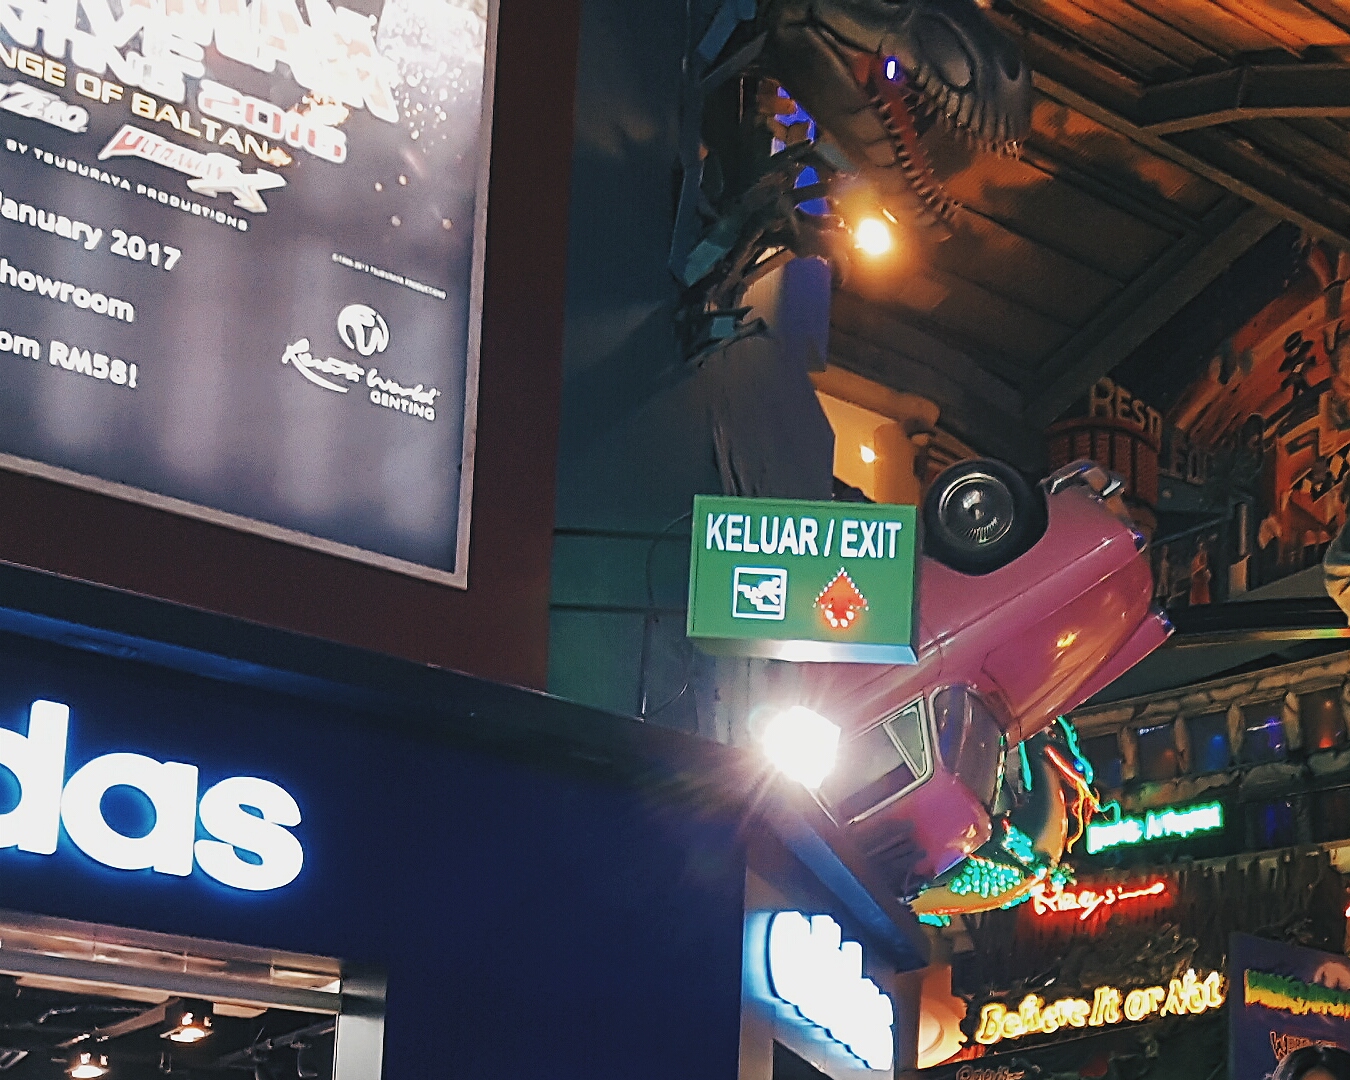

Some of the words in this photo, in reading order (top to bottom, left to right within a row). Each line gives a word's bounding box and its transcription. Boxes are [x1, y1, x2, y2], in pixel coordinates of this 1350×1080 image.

[75, 72, 124, 104] OF
[131, 92, 270, 160] BALTAN
[6, 138, 28, 154] BY
[136, 183, 249, 232] PRODUCTIONS
[0, 196, 103, 250] anuary
[110, 229, 182, 271] 2017
[49, 340, 138, 389] RM58!
[369, 390, 437, 422] GENTING
[706, 512, 819, 557] KELUAR
[840, 519, 903, 559] EXIT
[974, 993, 1091, 1045] Believe
[1088, 985, 1123, 1027] It
[1124, 985, 1166, 1022] or
[1160, 968, 1226, 1017] Not
